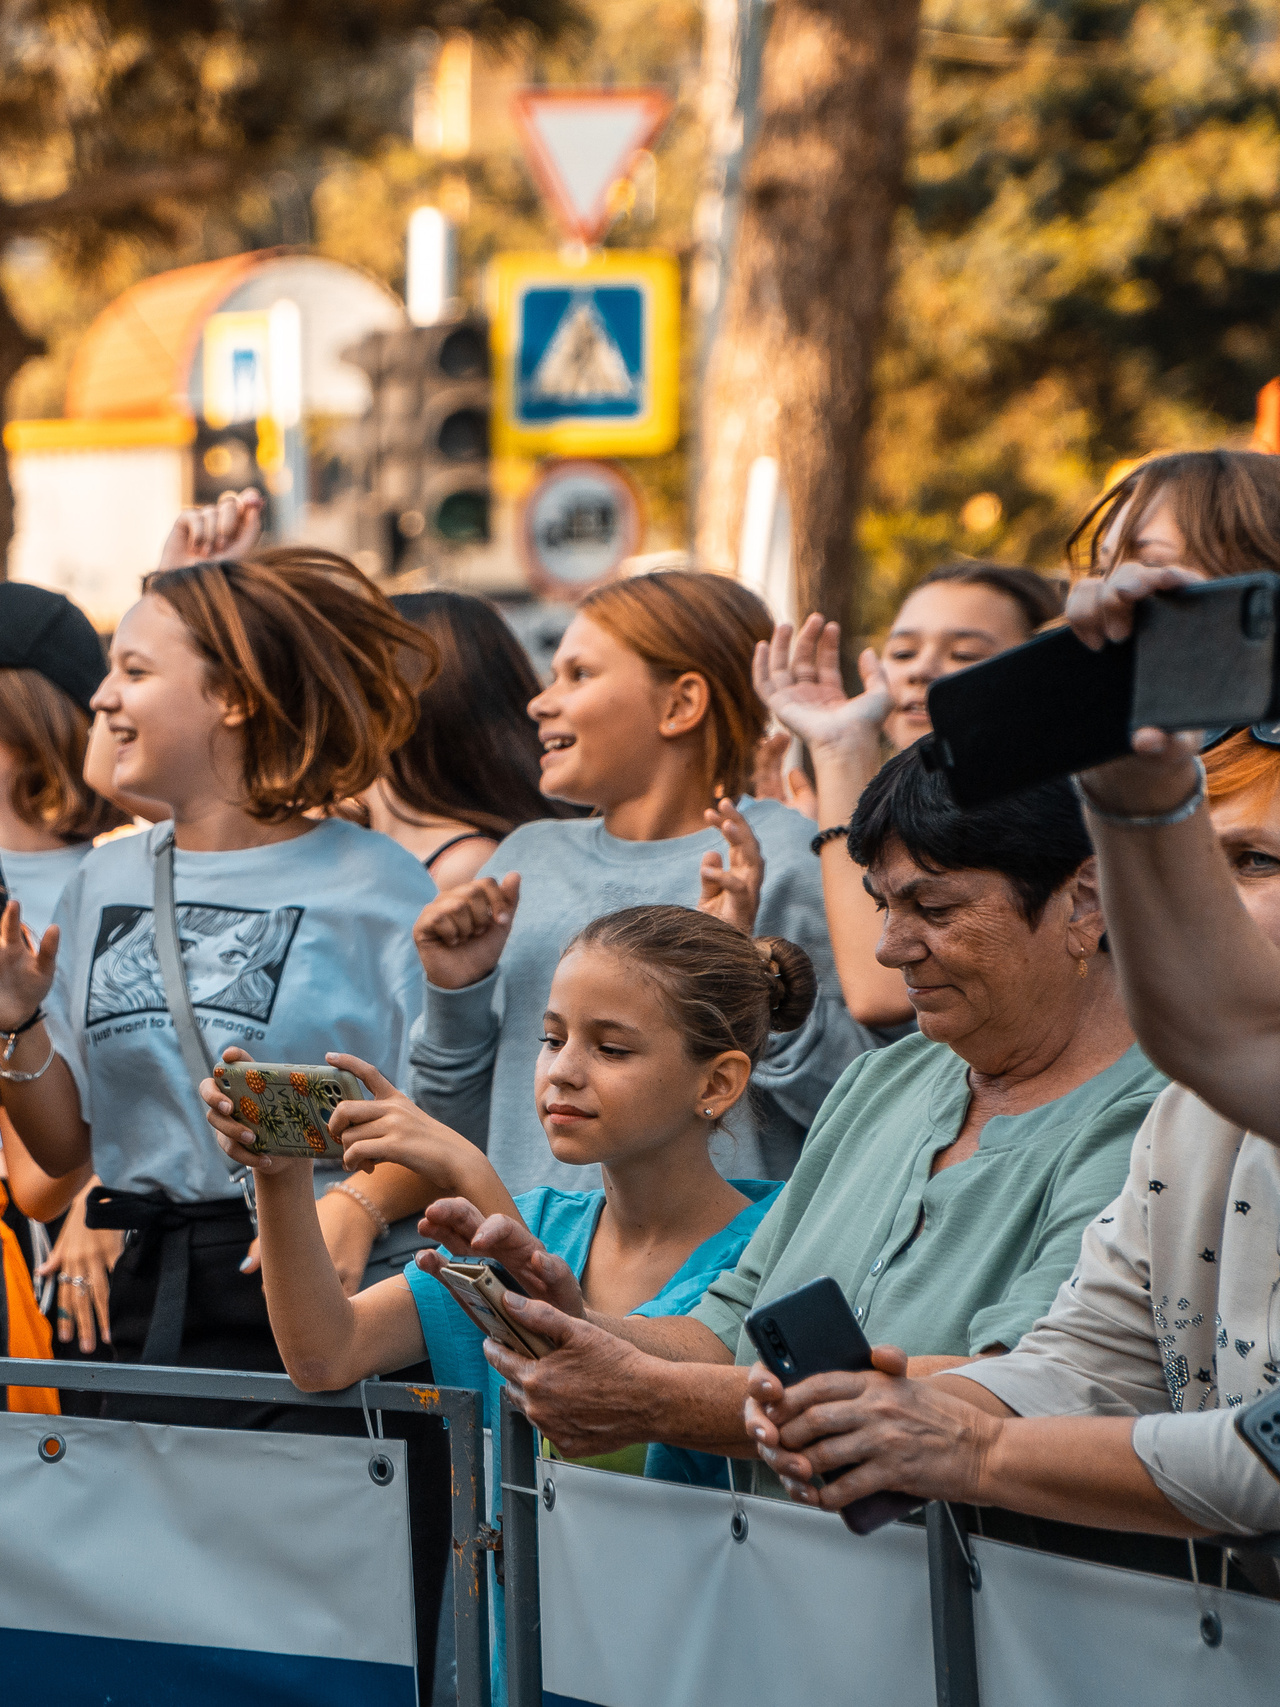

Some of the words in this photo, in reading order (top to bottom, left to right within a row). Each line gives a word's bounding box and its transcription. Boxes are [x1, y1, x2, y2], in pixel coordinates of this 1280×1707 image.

[91, 1027, 112, 1047] just
[115, 1018, 147, 1035] want
[150, 1015, 166, 1028] to
